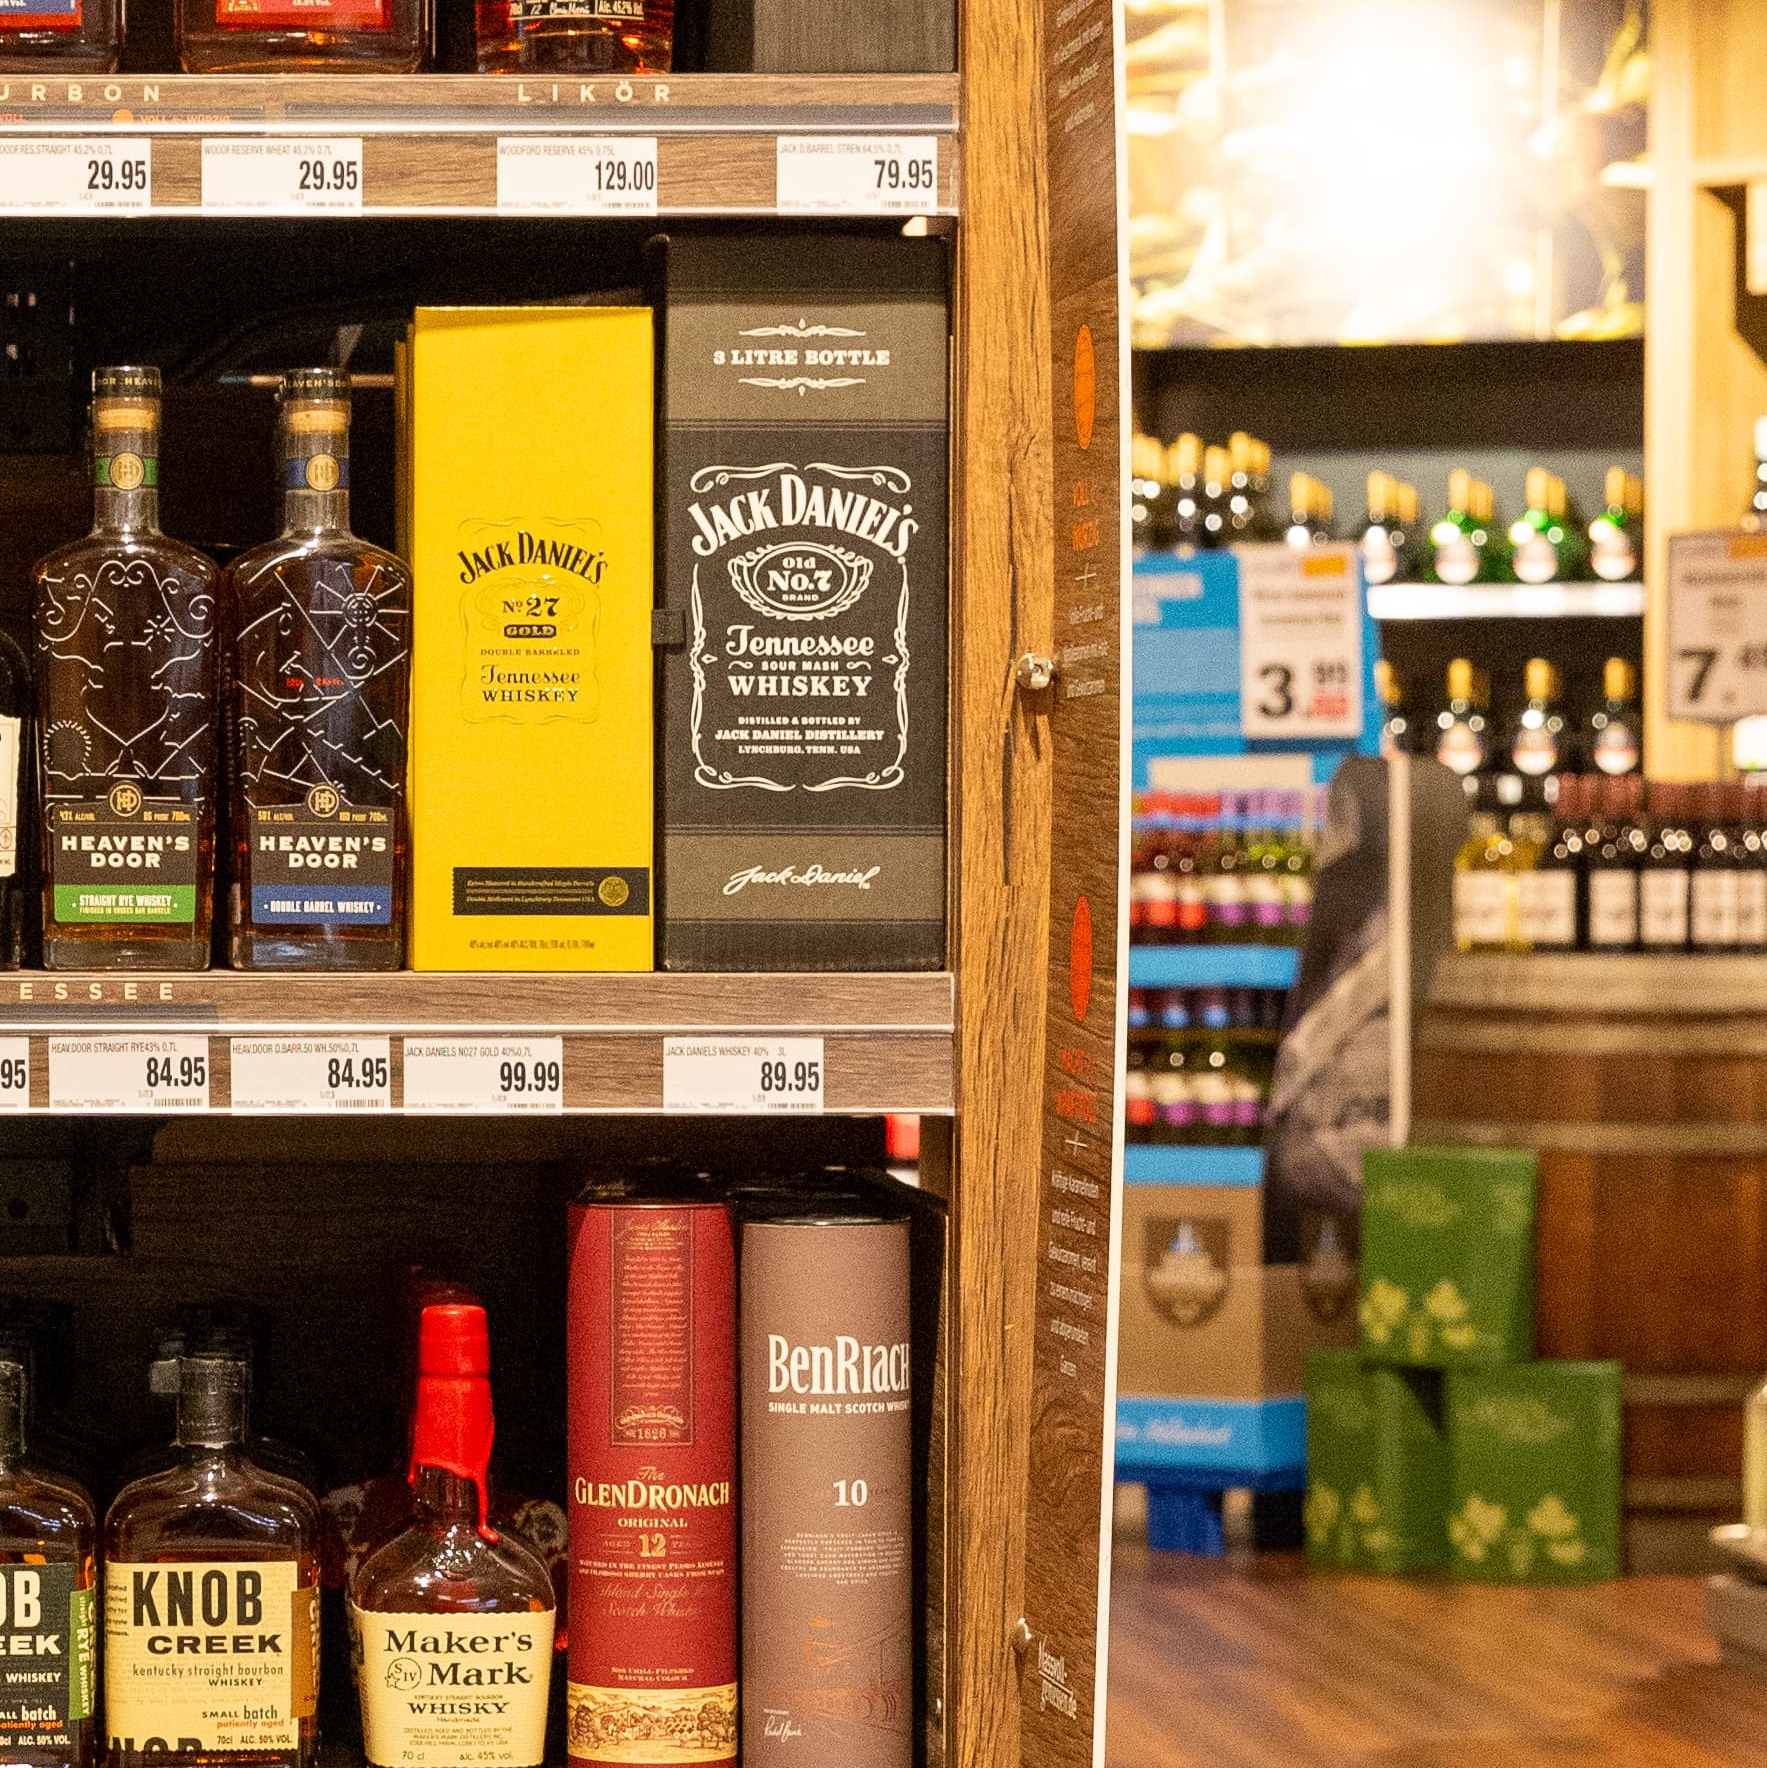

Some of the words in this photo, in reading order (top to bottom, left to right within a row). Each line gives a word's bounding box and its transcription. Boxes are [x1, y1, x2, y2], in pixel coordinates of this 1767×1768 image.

[518, 81, 670, 102] LIKÖR
[88, 160, 146, 189] 29.95
[299, 160, 358, 189] 29.95
[594, 160, 655, 191] 129.00
[874, 159, 933, 189] 79.95
[714, 350, 724, 365] 3
[731, 349, 797, 365] LITRE
[805, 349, 890, 365] BOTTLE
[688, 487, 771, 557] JACK
[780, 475, 919, 558] DANIEL'S
[458, 540, 514, 585] JACK
[517, 532, 608, 585] DANIEL'S
[782, 556, 816, 570] Old
[767, 569, 831, 592] No.7
[725, 624, 874, 656] Tennessee
[479, 664, 581, 684] Tennessee
[728, 675, 872, 696] WHISKEY
[482, 689, 579, 703] WHISKEY
[62, 836, 190, 851] HEAVEN'S
[90, 853, 160, 868] DOOR
[146, 1057, 206, 1088] 84.95
[328, 1058, 387, 1088] 84.95
[500, 1061, 560, 1092] 99.99
[761, 1062, 820, 1092] 89.95
[833, 1481, 867, 1506] 10
[618, 1517, 687, 1528] ORIGINAL
[638, 1534, 666, 1558] 12
[133, 1571, 262, 1626] KNOB
[147, 1634, 282, 1654] CREEK
[384, 1629, 533, 1653] Maker's
[6, 1672, 61, 1684] WHISKEY
[430, 1662, 532, 1686] Mark
[408, 1702, 511, 1714] WHISKY
